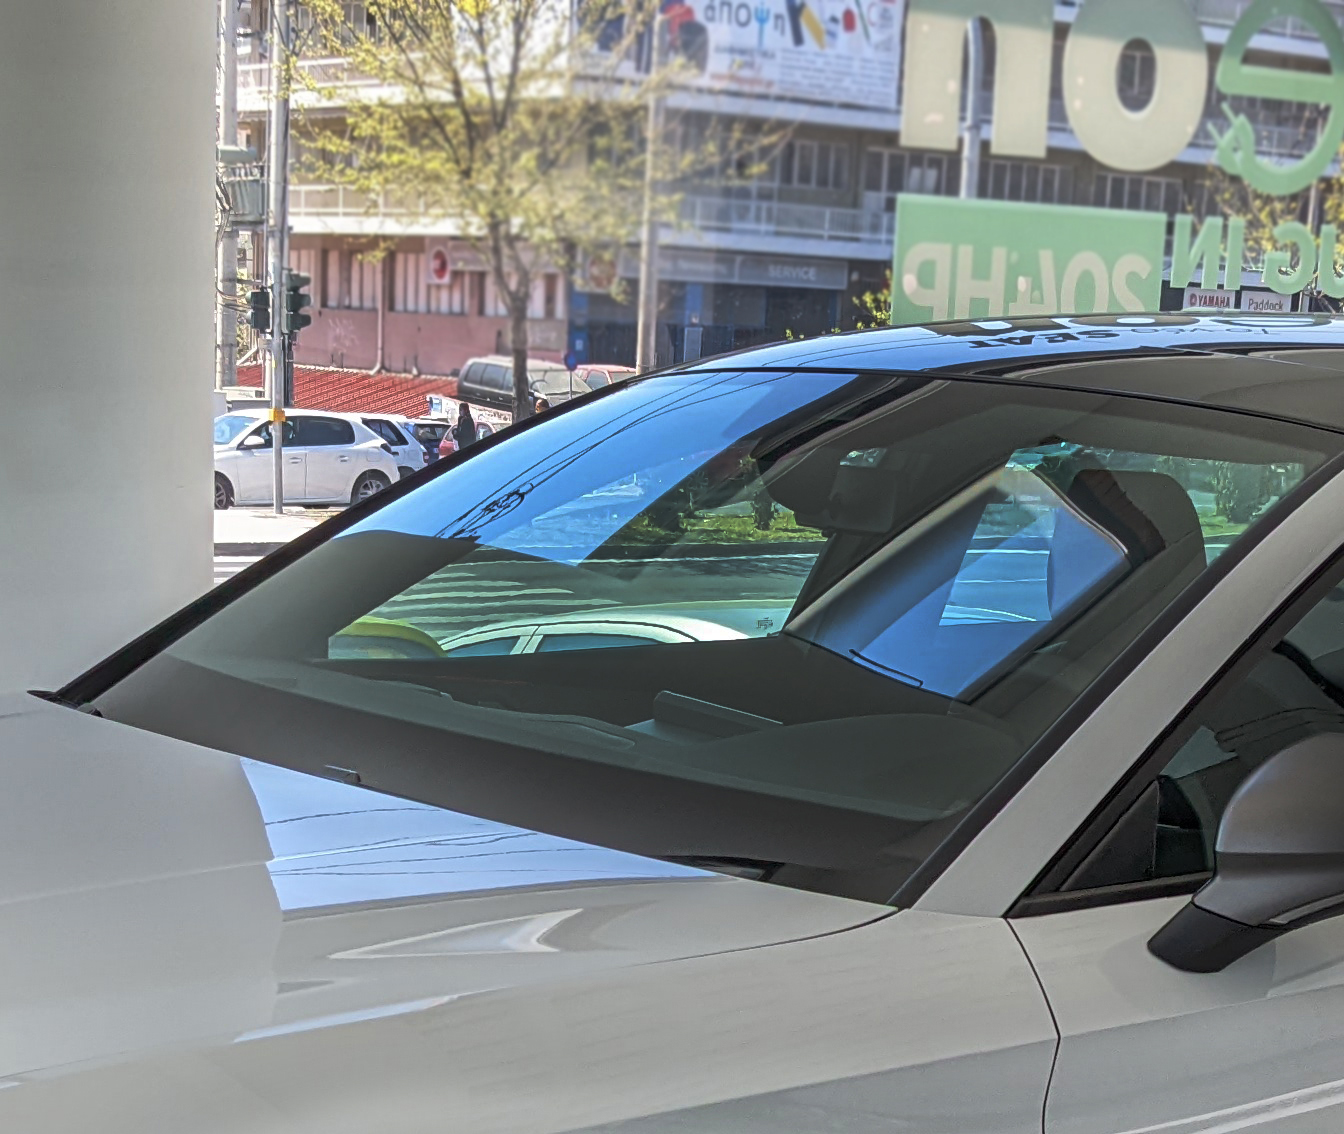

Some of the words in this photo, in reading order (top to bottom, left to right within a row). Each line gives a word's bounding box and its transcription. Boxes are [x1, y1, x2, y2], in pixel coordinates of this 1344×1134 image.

[767, 264, 817, 281] SERVICE
[1197, 293, 1230, 309] YAMAHA
[1248, 297, 1284, 312] Paddock
